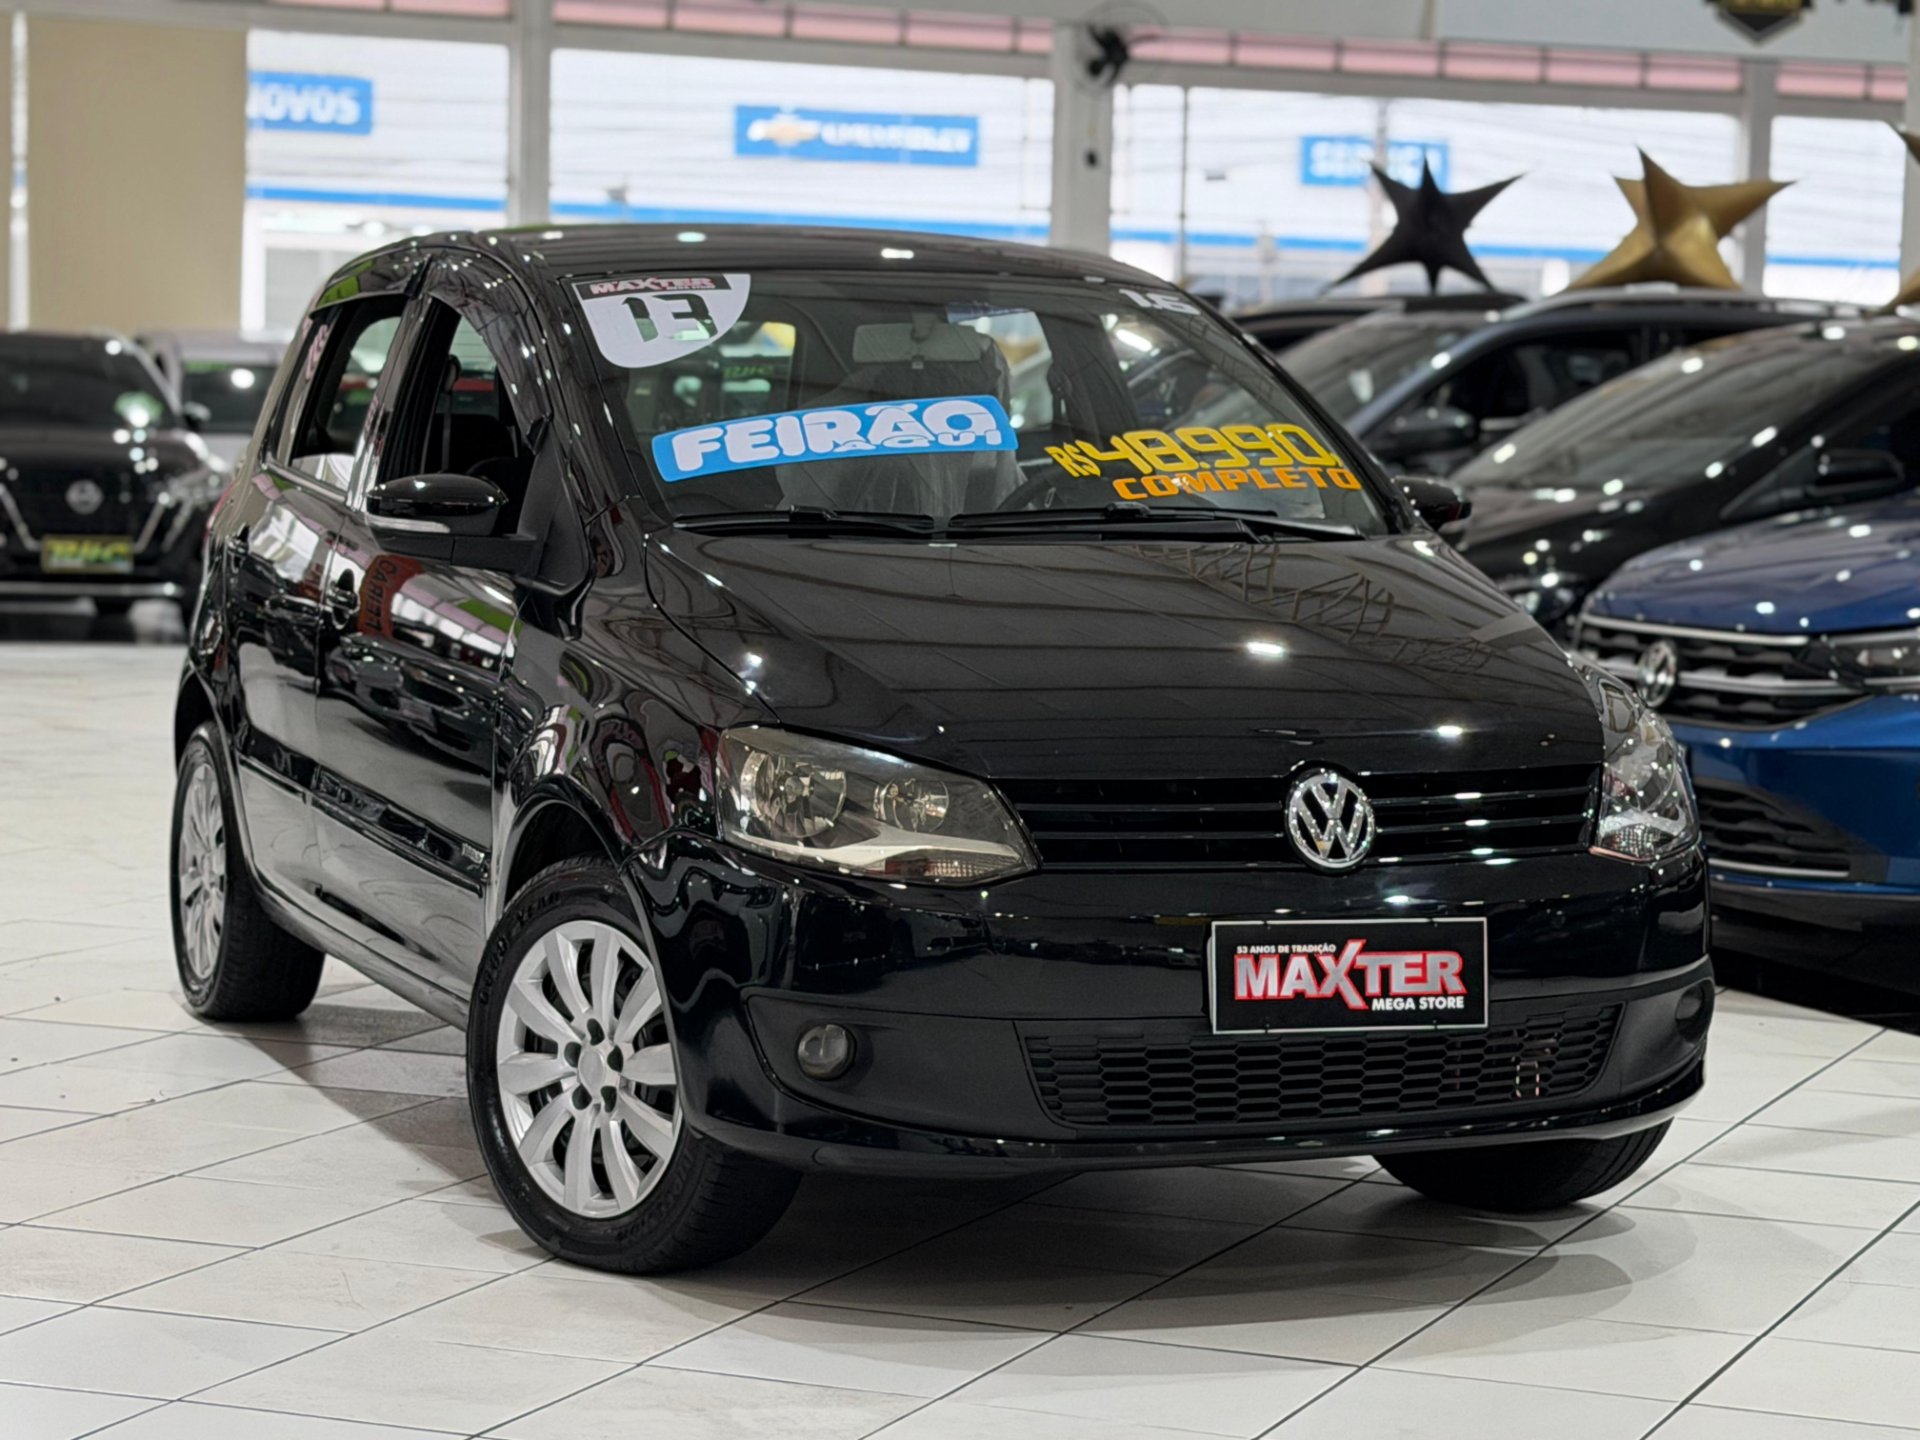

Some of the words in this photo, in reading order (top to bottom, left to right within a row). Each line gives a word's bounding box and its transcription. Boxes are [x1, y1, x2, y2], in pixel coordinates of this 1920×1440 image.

[590, 277, 714, 295] MAXTER
[622, 293, 718, 342] 13
[672, 400, 996, 472] FEIRÃO
[1112, 466, 1361, 500] COMPLETO
[1249, 945, 1276, 954] ANOS
[1277, 944, 1290, 953] DE
[1291, 942, 1336, 954] TRADIÇÃO
[1234, 939, 1468, 1011] MAXTER
[1371, 997, 1417, 1011] MEGA
[1418, 995, 1465, 1010] STORE
